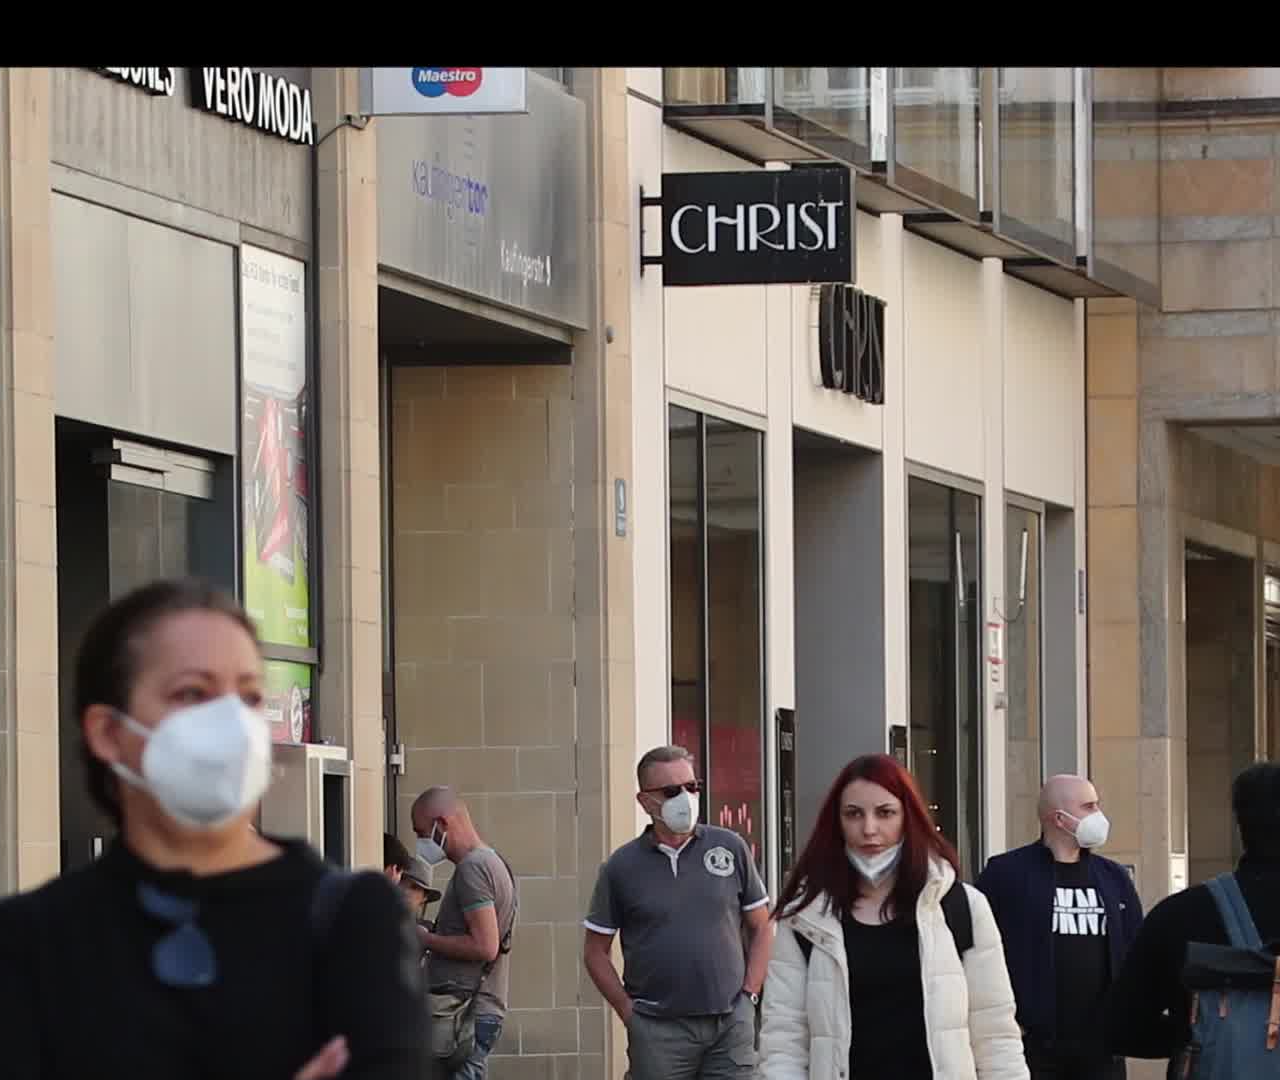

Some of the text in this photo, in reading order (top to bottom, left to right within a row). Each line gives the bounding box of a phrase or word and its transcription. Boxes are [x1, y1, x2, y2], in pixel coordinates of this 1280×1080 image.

[418, 69, 476, 84] Maestro
[202, 67, 313, 145] VERO MODA
[671, 200, 843, 254] CHRIST
